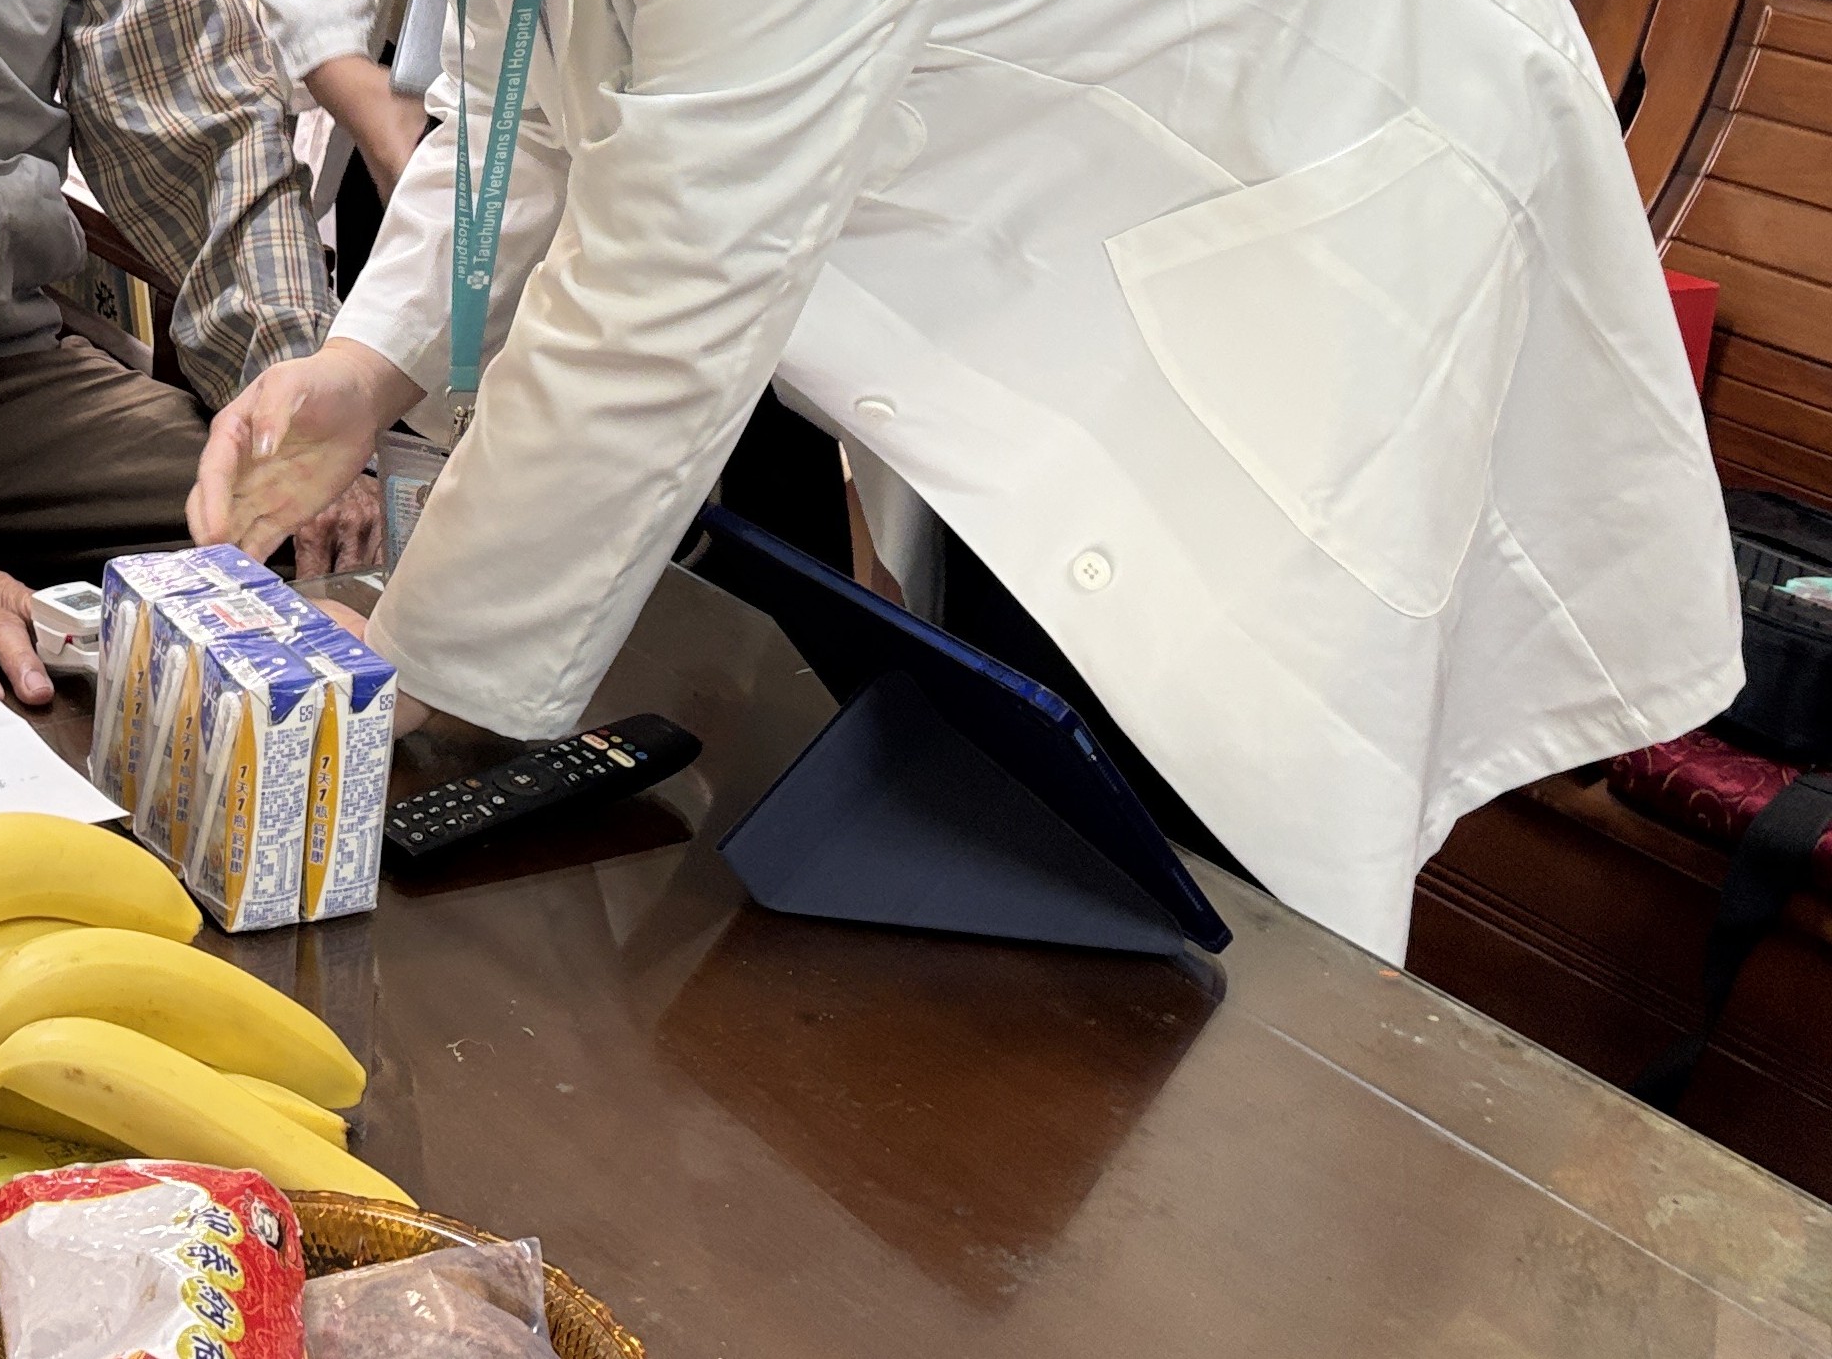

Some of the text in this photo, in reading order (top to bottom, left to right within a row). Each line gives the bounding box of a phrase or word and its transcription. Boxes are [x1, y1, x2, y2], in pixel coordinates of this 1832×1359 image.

[472, 7, 534, 265] Taichung Veterans General Hospital
[230, 764, 250, 874] 1天1瓶 鈣健康
[310, 755, 332, 865] 1天1瓶 鈣健康
